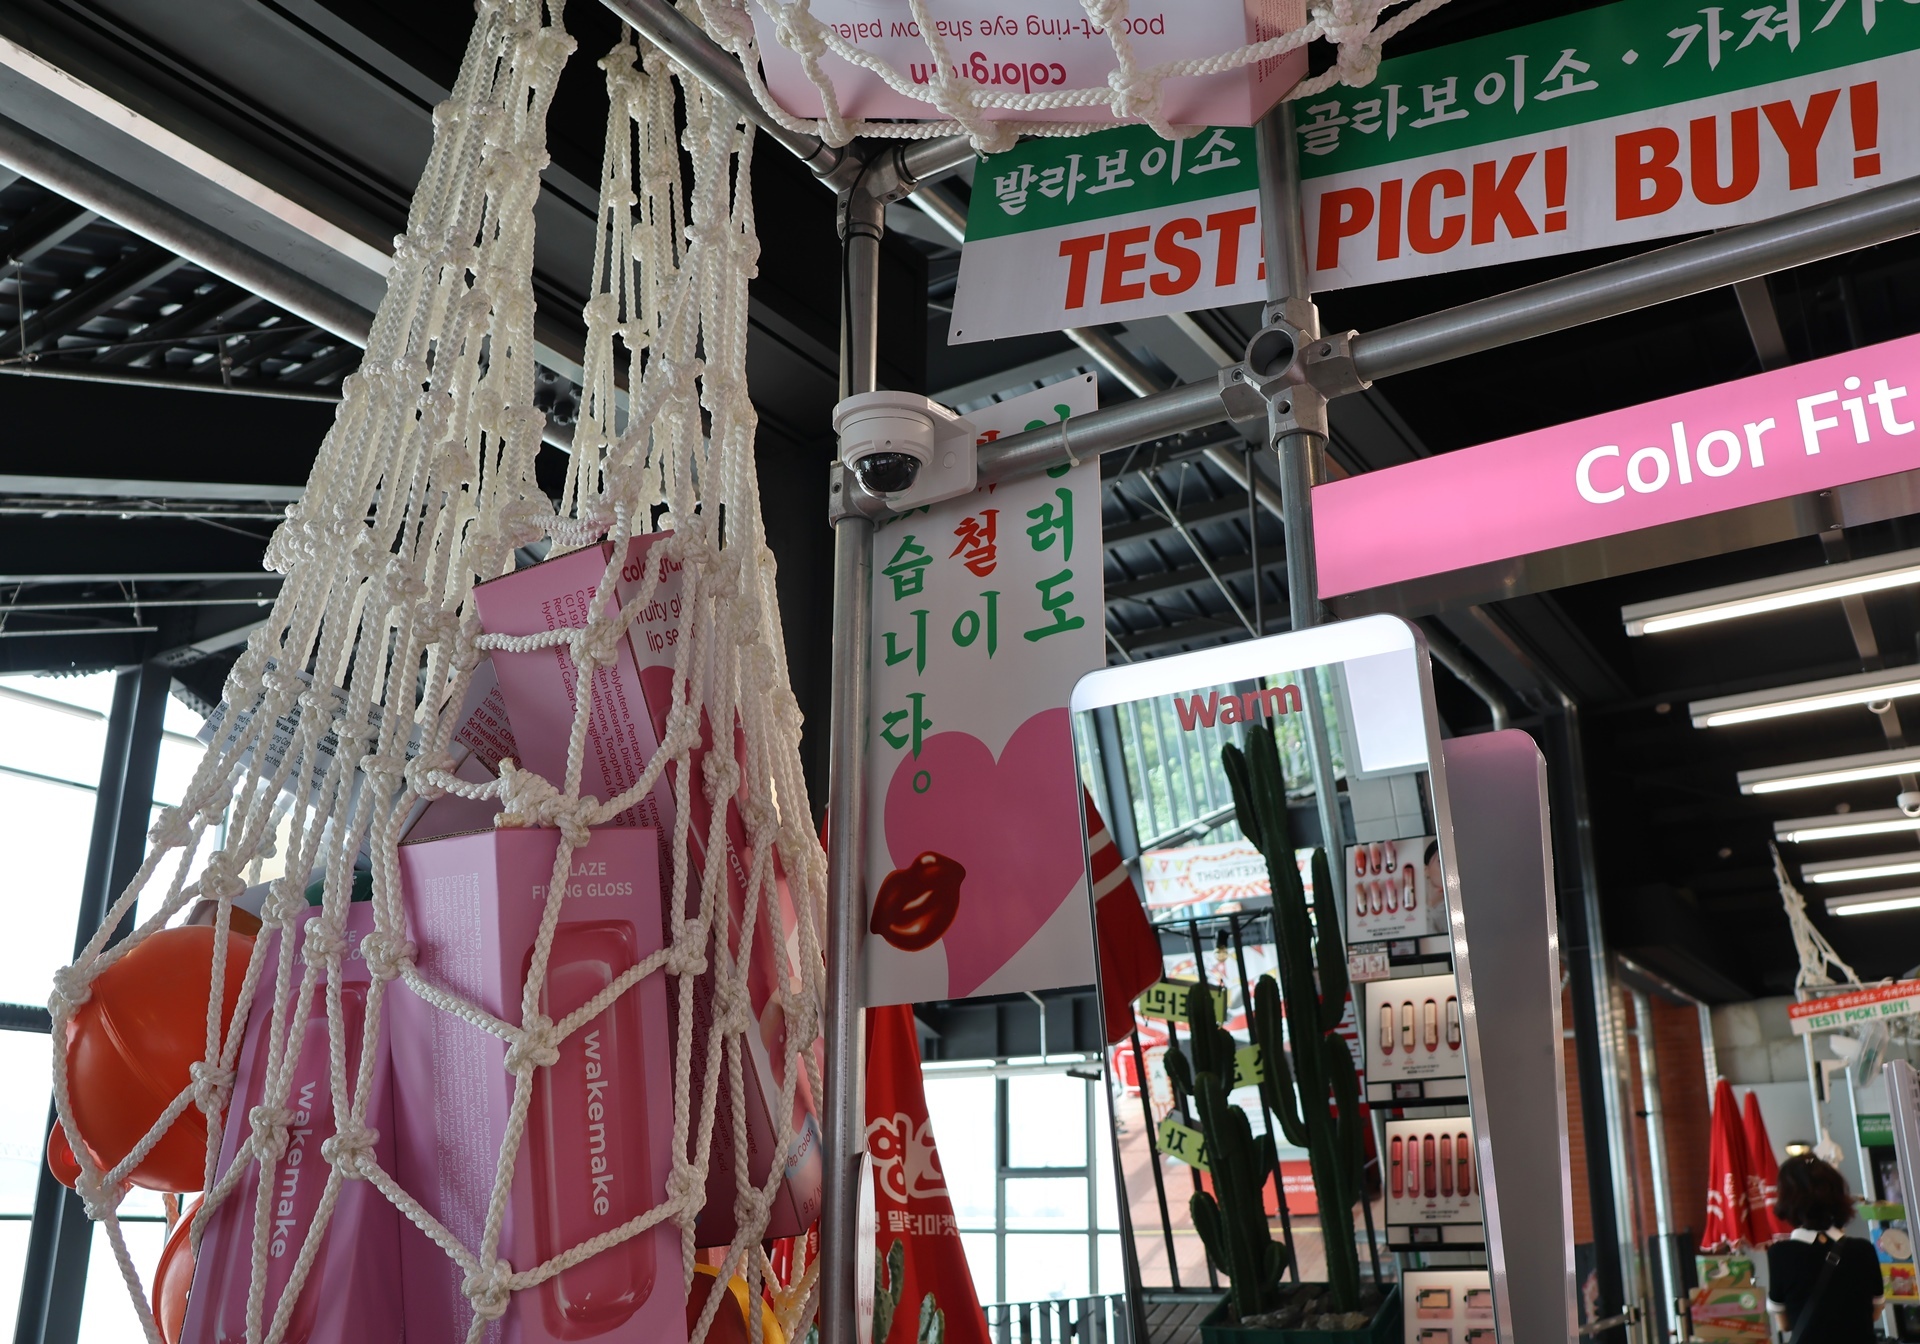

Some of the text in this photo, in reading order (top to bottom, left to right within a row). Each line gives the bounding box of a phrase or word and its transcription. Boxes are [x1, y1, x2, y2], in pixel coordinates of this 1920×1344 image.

[891, 21, 973, 42] shaow
[980, 16, 1018, 36] eye
[910, 51, 1066, 94] colorgrm
[992, 129, 1242, 216] 발라보이소
[1297, 48, 1600, 156] 골라보이소
[1316, 145, 1568, 271] PICK!
[1615, 80, 1881, 221] BUY!
[1575, 376, 1916, 504] Color Fit
[553, 597, 565, 617] Red
[636, 601, 668, 626] ruity
[646, 629, 665, 654] lip
[561, 671, 577, 702] Castor
[474, 707, 487, 720] EU
[485, 716, 498, 729] RP
[1174, 683, 1303, 732] Warm
[460, 726, 474, 740] UK
[471, 736, 484, 748] RP
[466, 716, 512, 755] Schwalbach
[583, 708, 605, 756] angifera
[598, 756, 614, 786] Indica
[603, 690, 626, 747] Isostearate,
[637, 804, 650, 828] Mala
[603, 736, 627, 791] Tocopheryl
[570, 862, 606, 876] LAZE
[587, 882, 632, 897] GLOSS
[472, 872, 482, 950] INGREDIENTS
[1808, 999, 1910, 1029] TEST! PICK! BUY!
[472, 1025, 481, 1080] opolymer,
[582, 1029, 610, 1217] wakemake
[271, 1080, 316, 1259] wakemake
